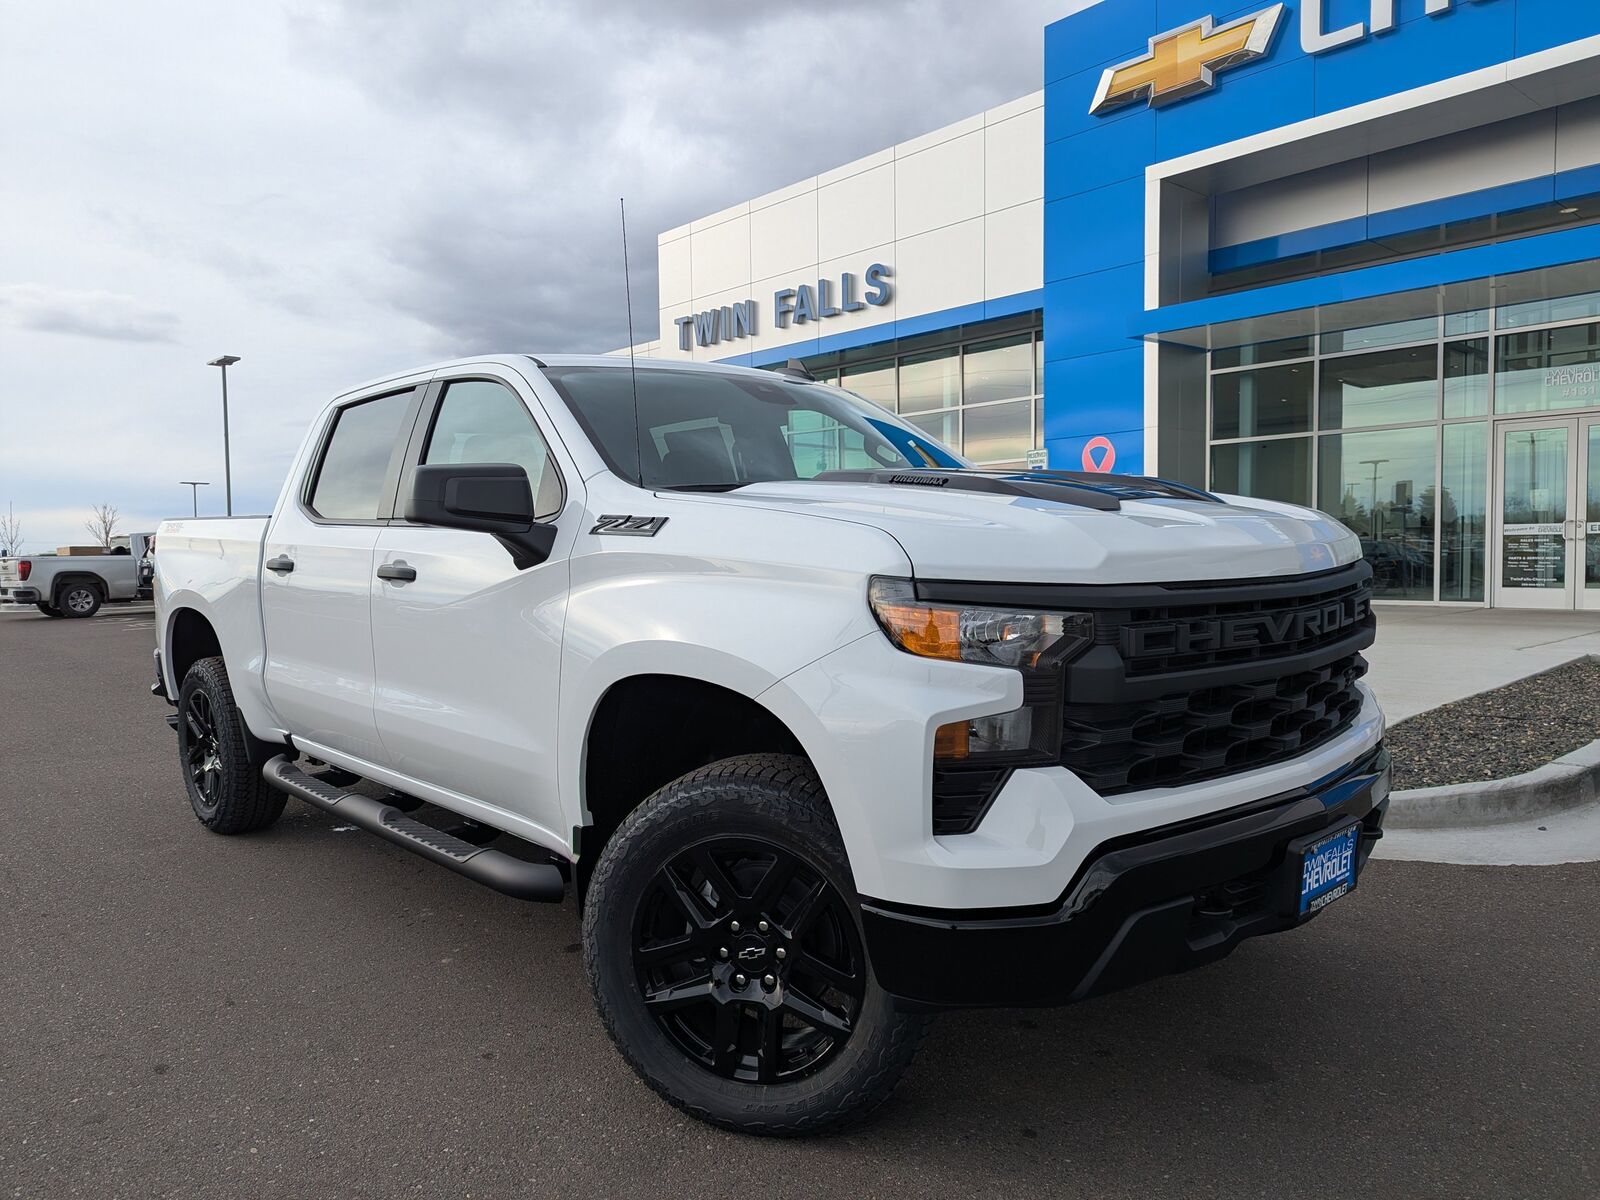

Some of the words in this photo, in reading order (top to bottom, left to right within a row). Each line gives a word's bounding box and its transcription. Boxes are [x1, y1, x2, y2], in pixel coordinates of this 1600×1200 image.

[674, 299, 758, 351] TWIN
[774, 263, 893, 329] FALLS
[1544, 371, 1600, 387] CHEVROL
[888, 474, 949, 487] TURBOMAX
[589, 514, 669, 537] Z71
